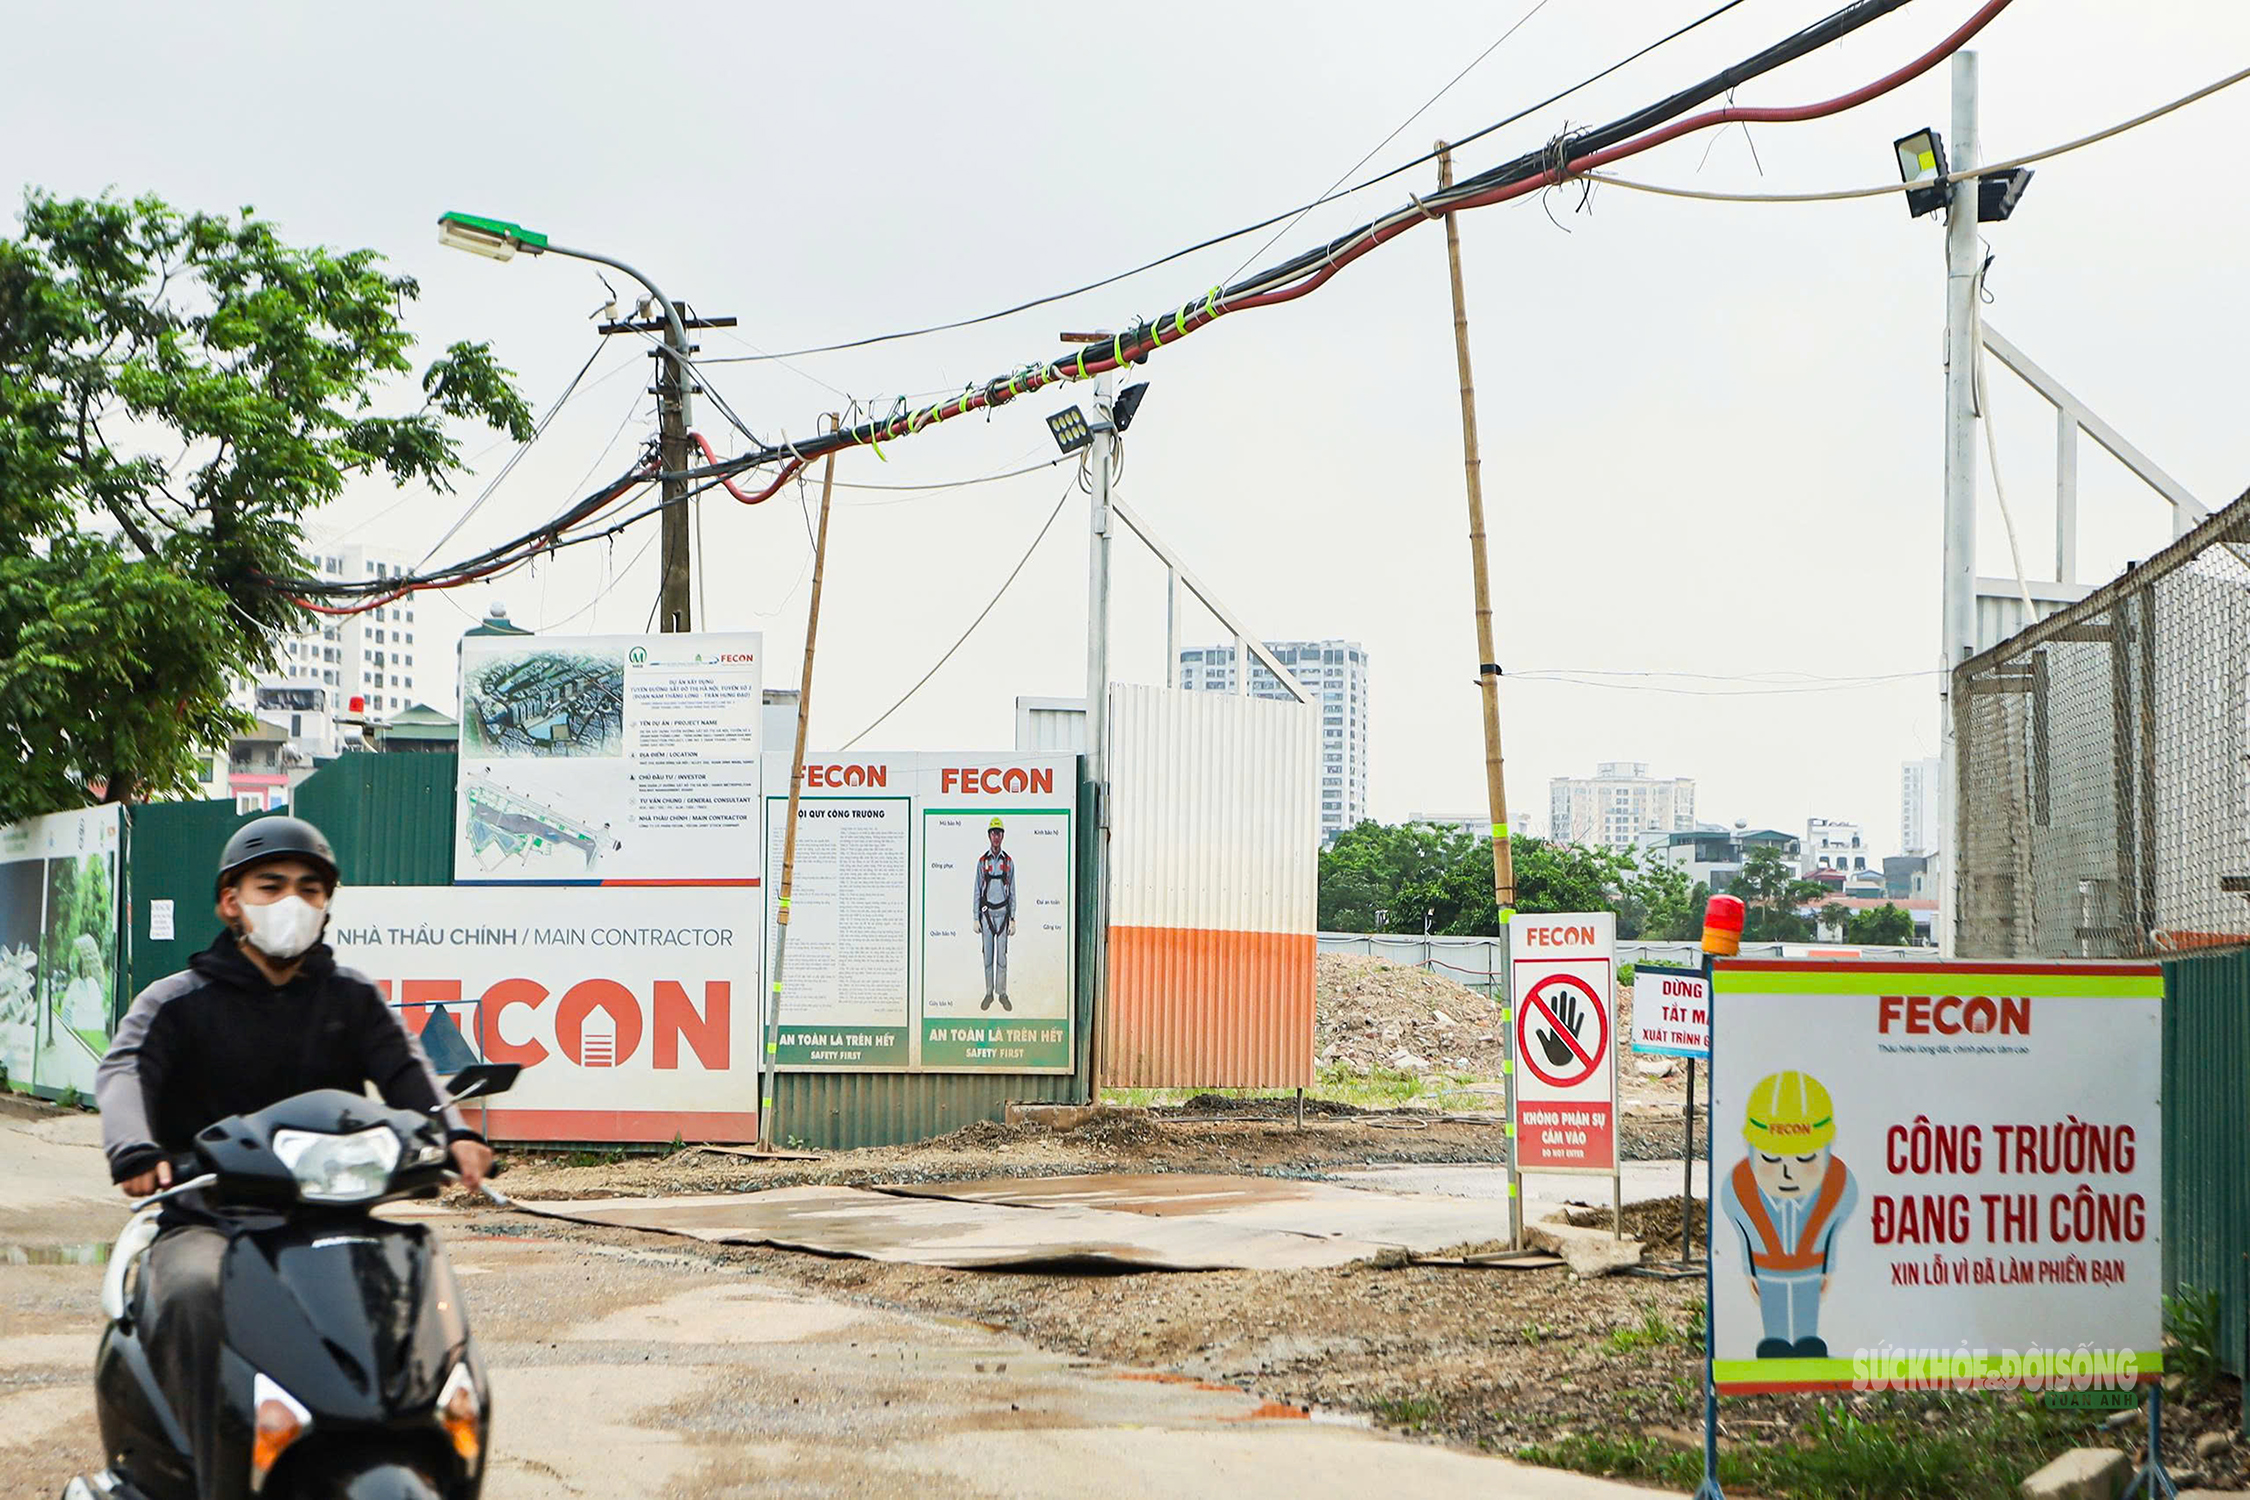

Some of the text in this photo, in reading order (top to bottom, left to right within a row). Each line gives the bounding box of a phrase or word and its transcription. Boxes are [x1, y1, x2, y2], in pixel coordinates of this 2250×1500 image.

[720, 654, 754, 662] FECON
[941, 767, 1053, 794] FECON
[337, 922, 734, 946] NHÀ THẦU CHÍNH / MAIN CONTRACTOR
[1526, 926, 1594, 946] FECON
[1662, 978, 1702, 998] DỪNG
[374, 977, 731, 1070] ECON
[1878, 995, 2031, 1036] FECON
[779, 1032, 895, 1046] AN TOÀN LÀ TRÊN HẾT
[929, 1026, 1064, 1043] AN TOÀN LÀ TRÊN HẾT
[1671, 1030, 1700, 1046] TRÌNH
[810, 1051, 862, 1060] SAFETY FIRST
[966, 1048, 1024, 1058] SAFETY FIRST
[1523, 1108, 1606, 1130] KHÔNG PHẬN SỰ
[1770, 1124, 1811, 1135] FECON
[1542, 1148, 1552, 1158] DO
[1552, 1149, 1564, 1158] NOT
[1886, 1114, 2137, 1175] CÔNG TRƯỜNG
[1871, 1183, 2146, 1244] ĐANG THI CÔNG
[1890, 1253, 2126, 1288] XIN LỖI VÌ ĐÃ LÀM PHIỀN BẠN
